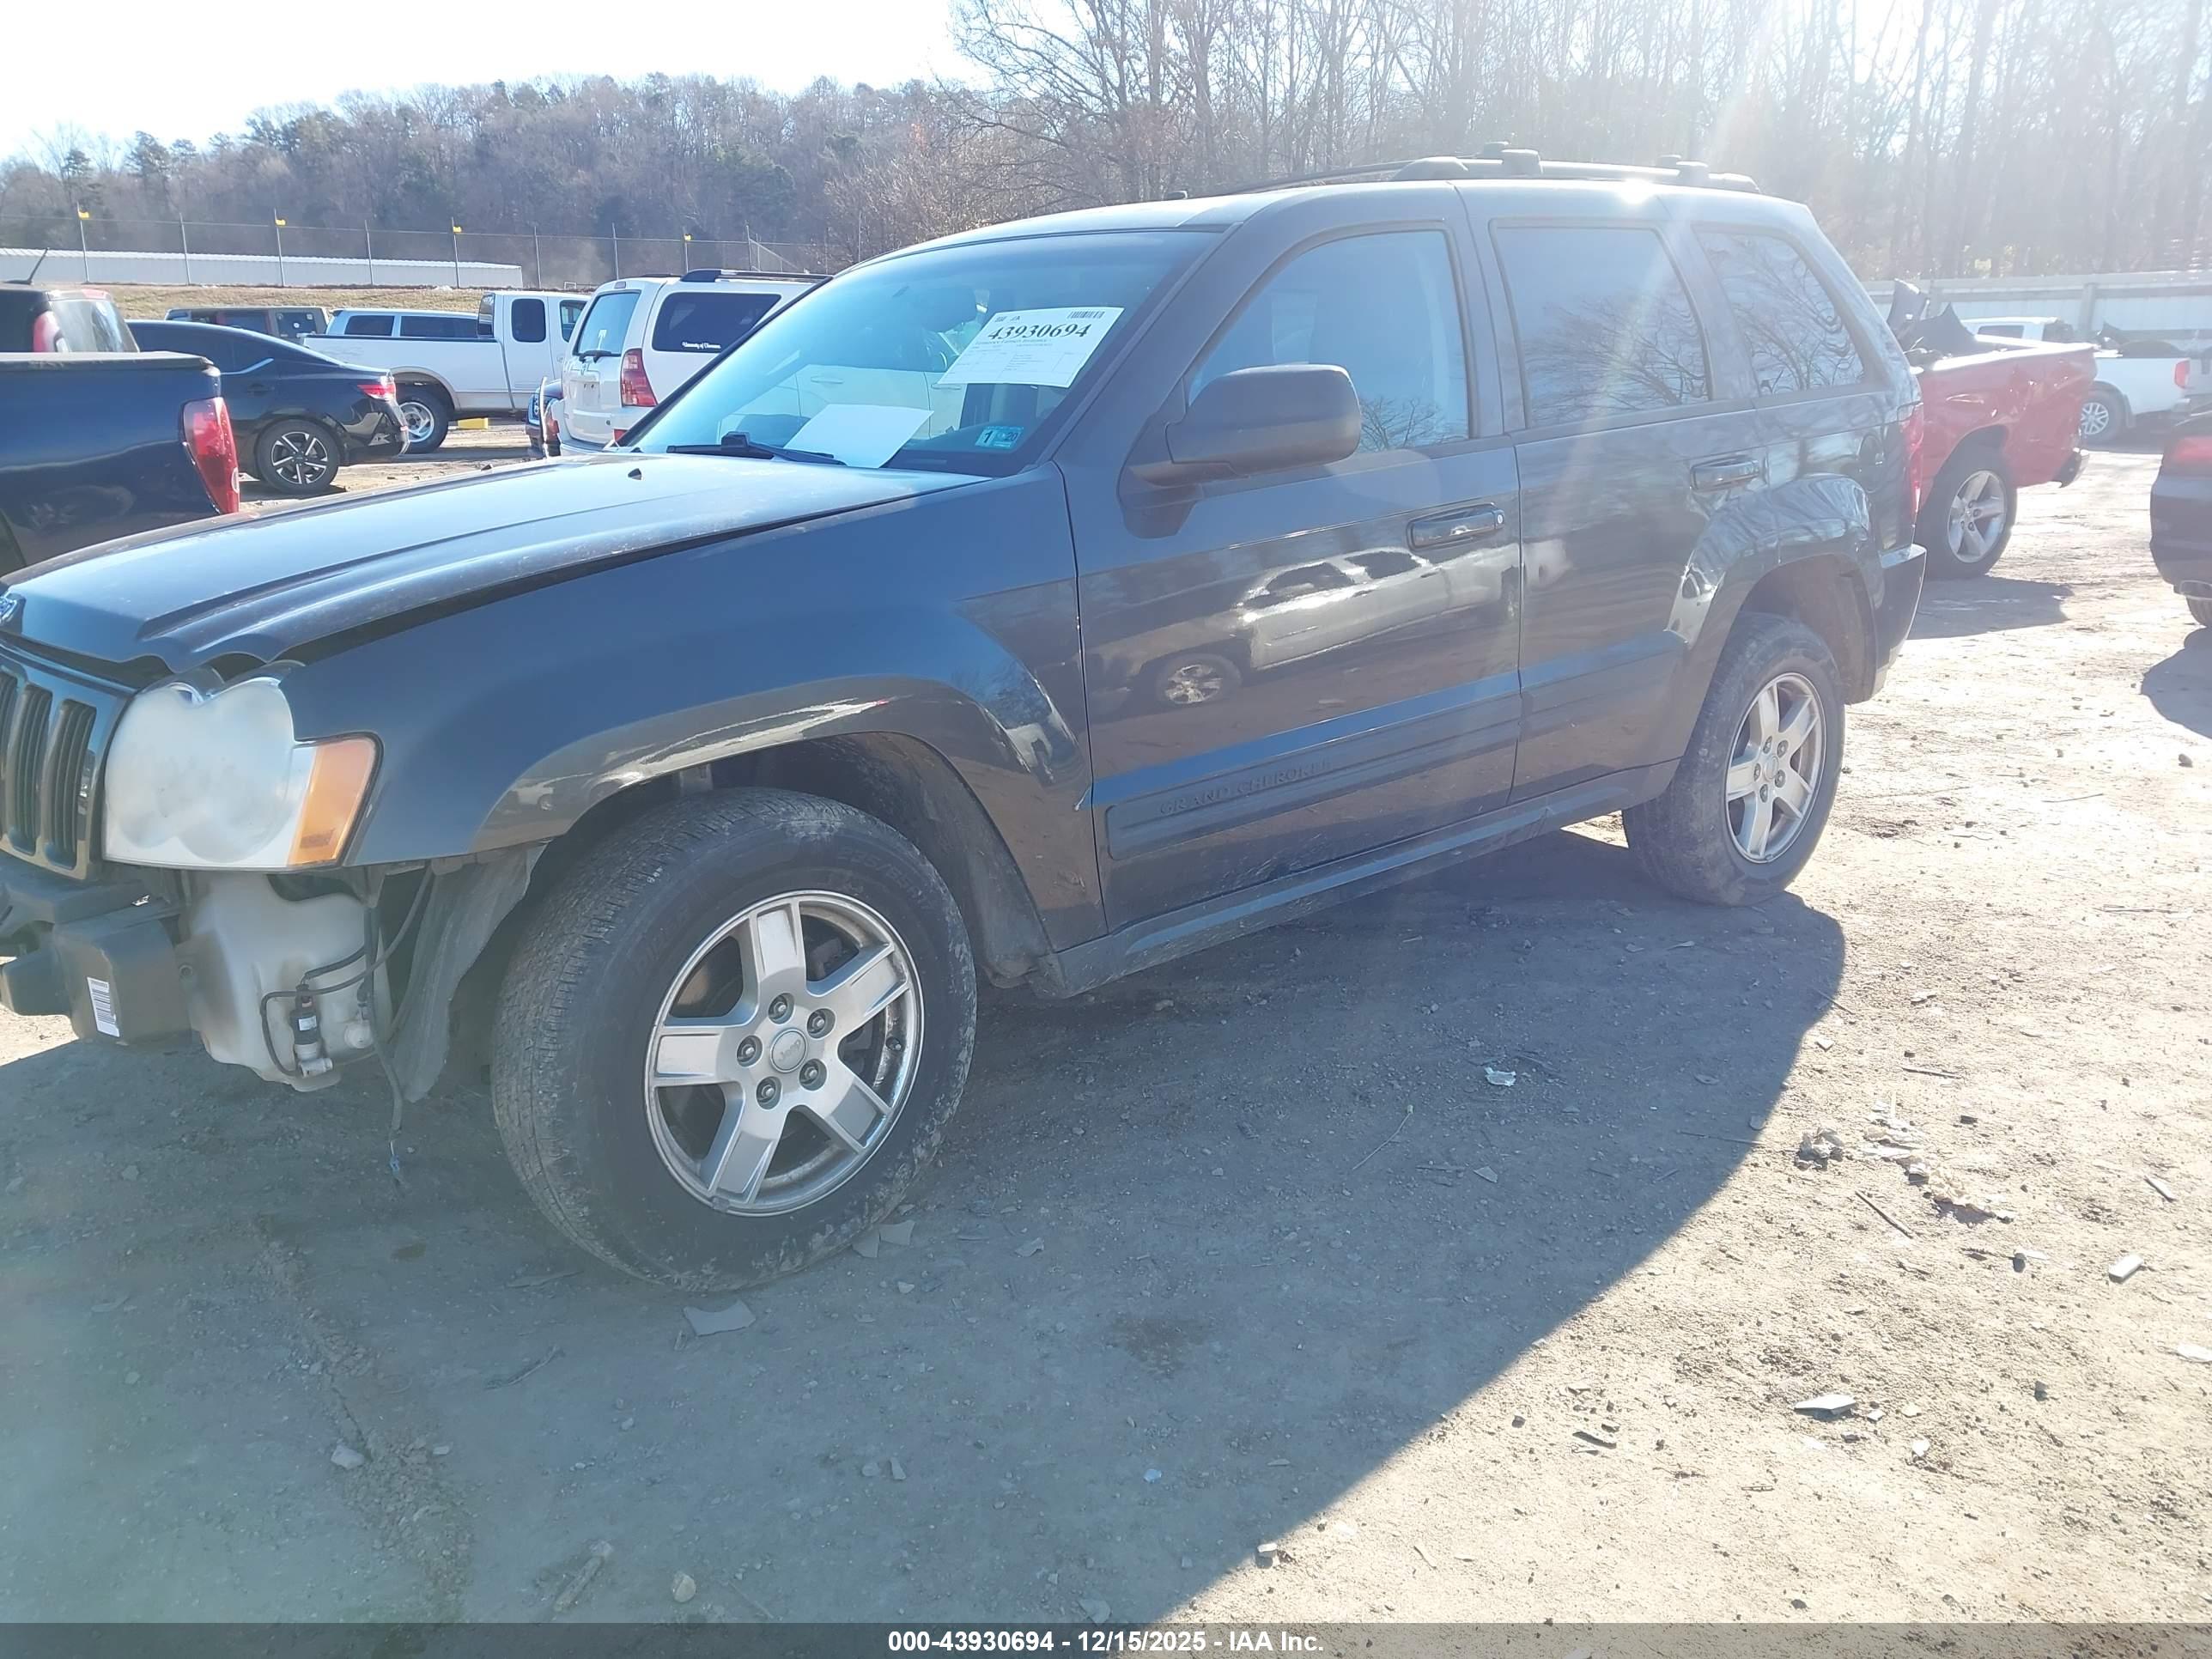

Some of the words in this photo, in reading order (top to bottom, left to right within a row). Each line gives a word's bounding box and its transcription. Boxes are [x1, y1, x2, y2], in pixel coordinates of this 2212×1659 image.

[988, 323, 1092, 340] 43930694
[1159, 787, 1231, 815] GRAND
[1237, 756, 1333, 794] CHEROKEE
[778, 1039, 802, 1062] Jeep
